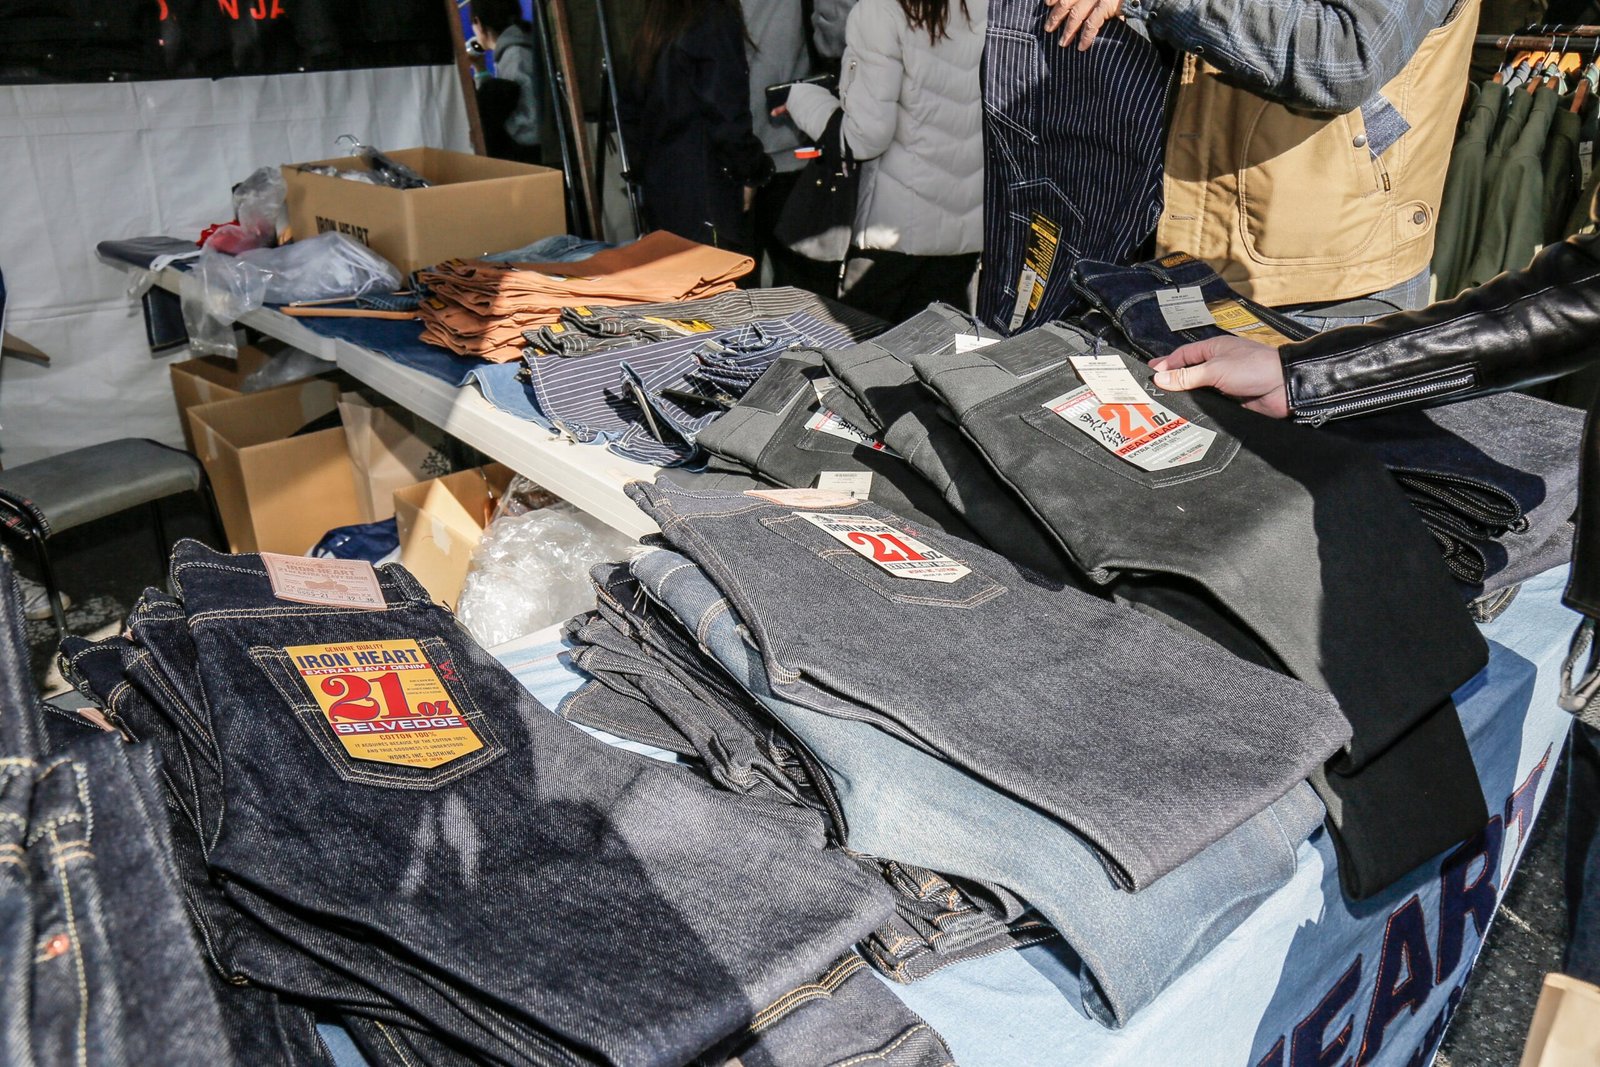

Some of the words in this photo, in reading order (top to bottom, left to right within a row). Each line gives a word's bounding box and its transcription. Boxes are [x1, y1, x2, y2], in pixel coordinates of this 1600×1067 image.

[1097, 403, 1159, 439] 21
[1119, 437, 1150, 455] REAL
[1148, 419, 1184, 440] BLACK
[847, 531, 929, 562] 21
[319, 568, 355, 576] HEART
[324, 645, 355, 653] GENUINE
[356, 643, 384, 651] QUALITY
[296, 652, 351, 669] IRON
[353, 649, 420, 666] HEART
[348, 665, 388, 673] HEAVY
[320, 672, 422, 722] 21
[335, 717, 463, 734] SELVEDGE
[415, 731, 437, 739] 100%
[1257, 742, 1553, 1067] EART
